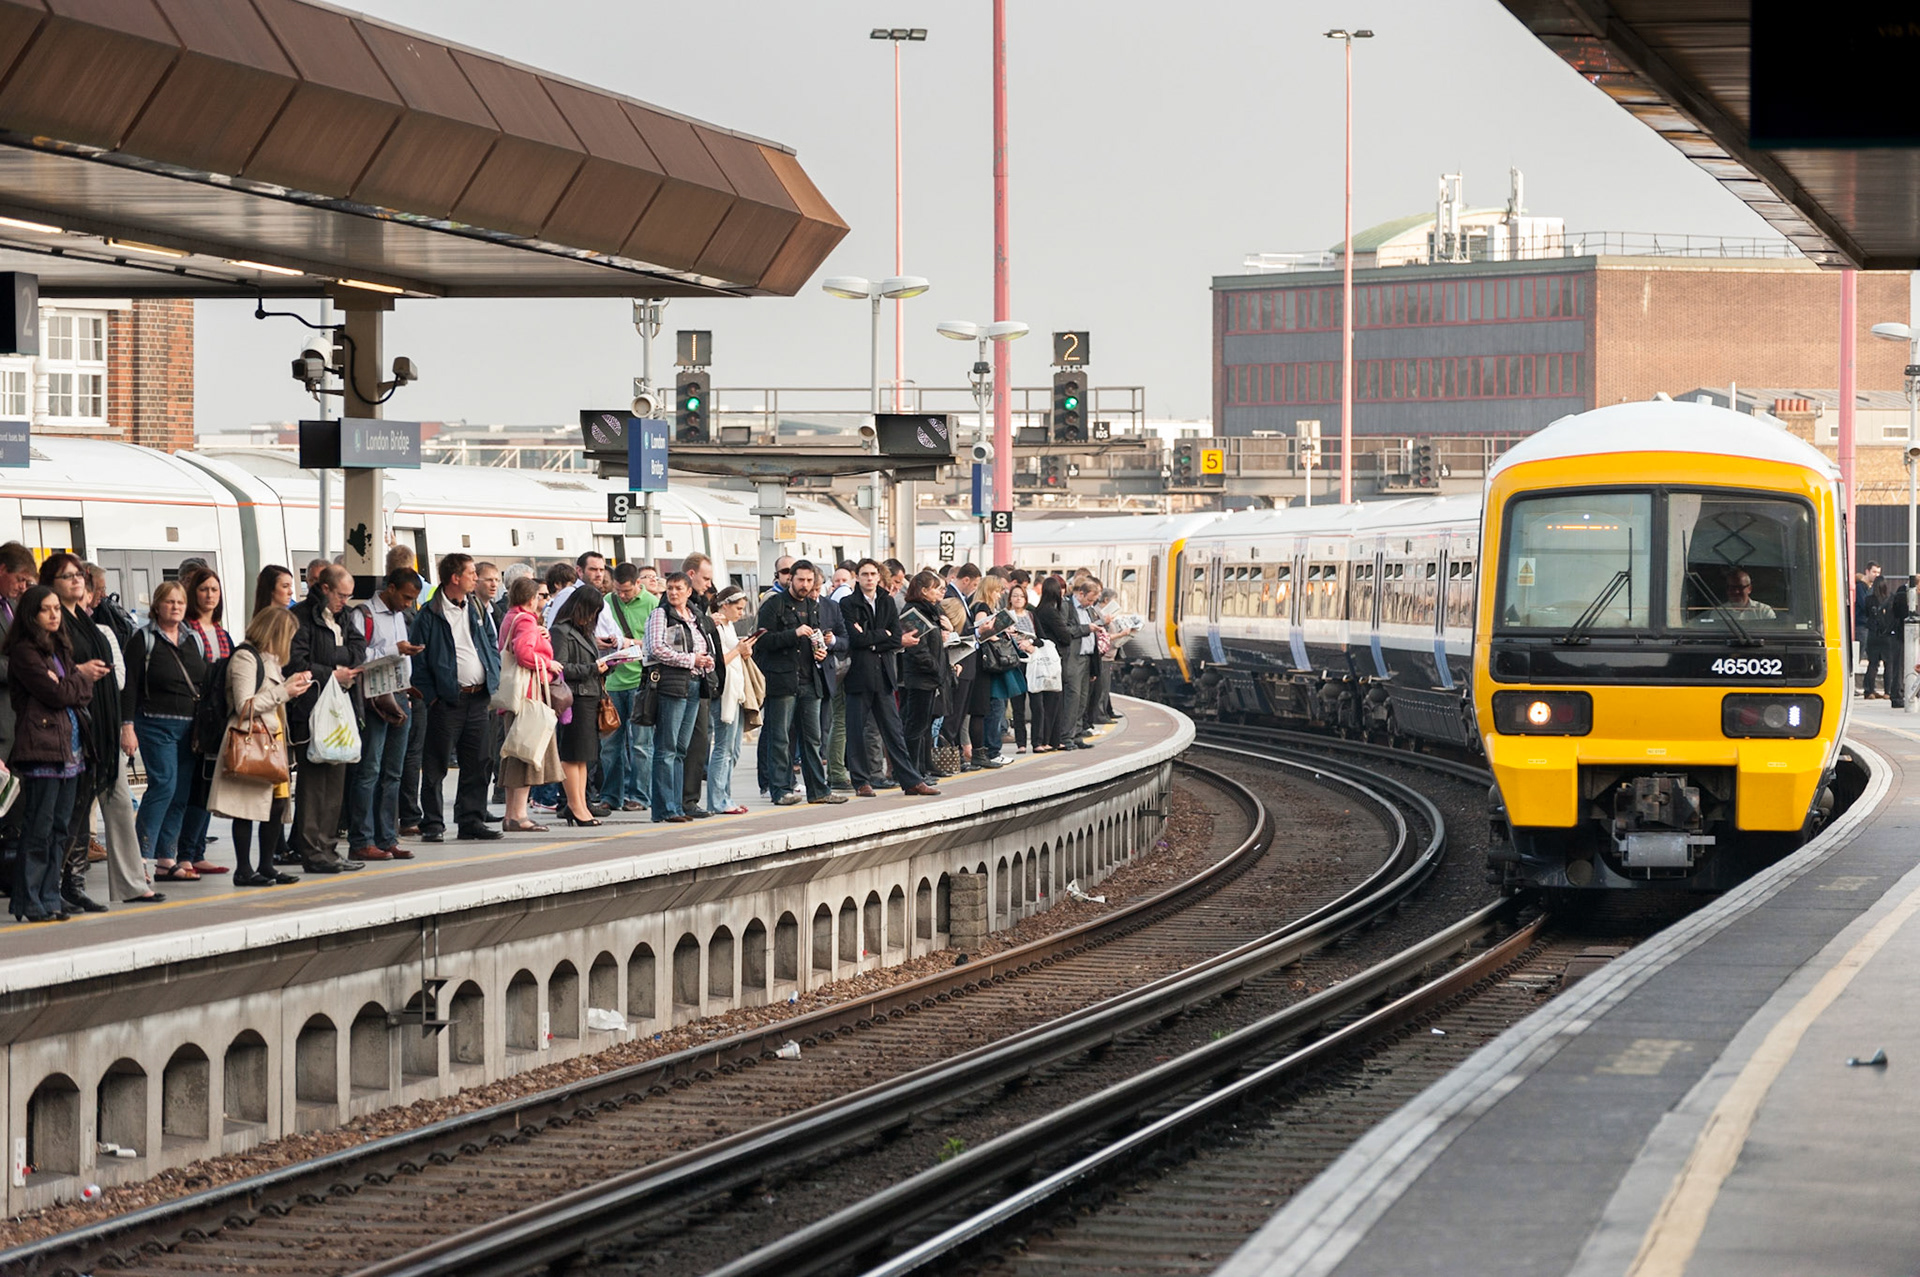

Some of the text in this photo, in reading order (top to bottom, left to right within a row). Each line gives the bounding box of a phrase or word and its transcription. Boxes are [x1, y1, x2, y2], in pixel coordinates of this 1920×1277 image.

[22, 286, 33, 337] 2
[1063, 333, 1080, 361] 2
[365, 430, 410, 455] London Bridge
[650, 433, 666, 449] London
[651, 459, 664, 479] Bridge
[1206, 453, 1218, 469] 5
[614, 495, 629, 516] 8
[995, 512, 1008, 528] 8
[940, 532, 954, 544] 10
[940, 545, 954, 556] 12
[1711, 658, 1783, 675] 465032
